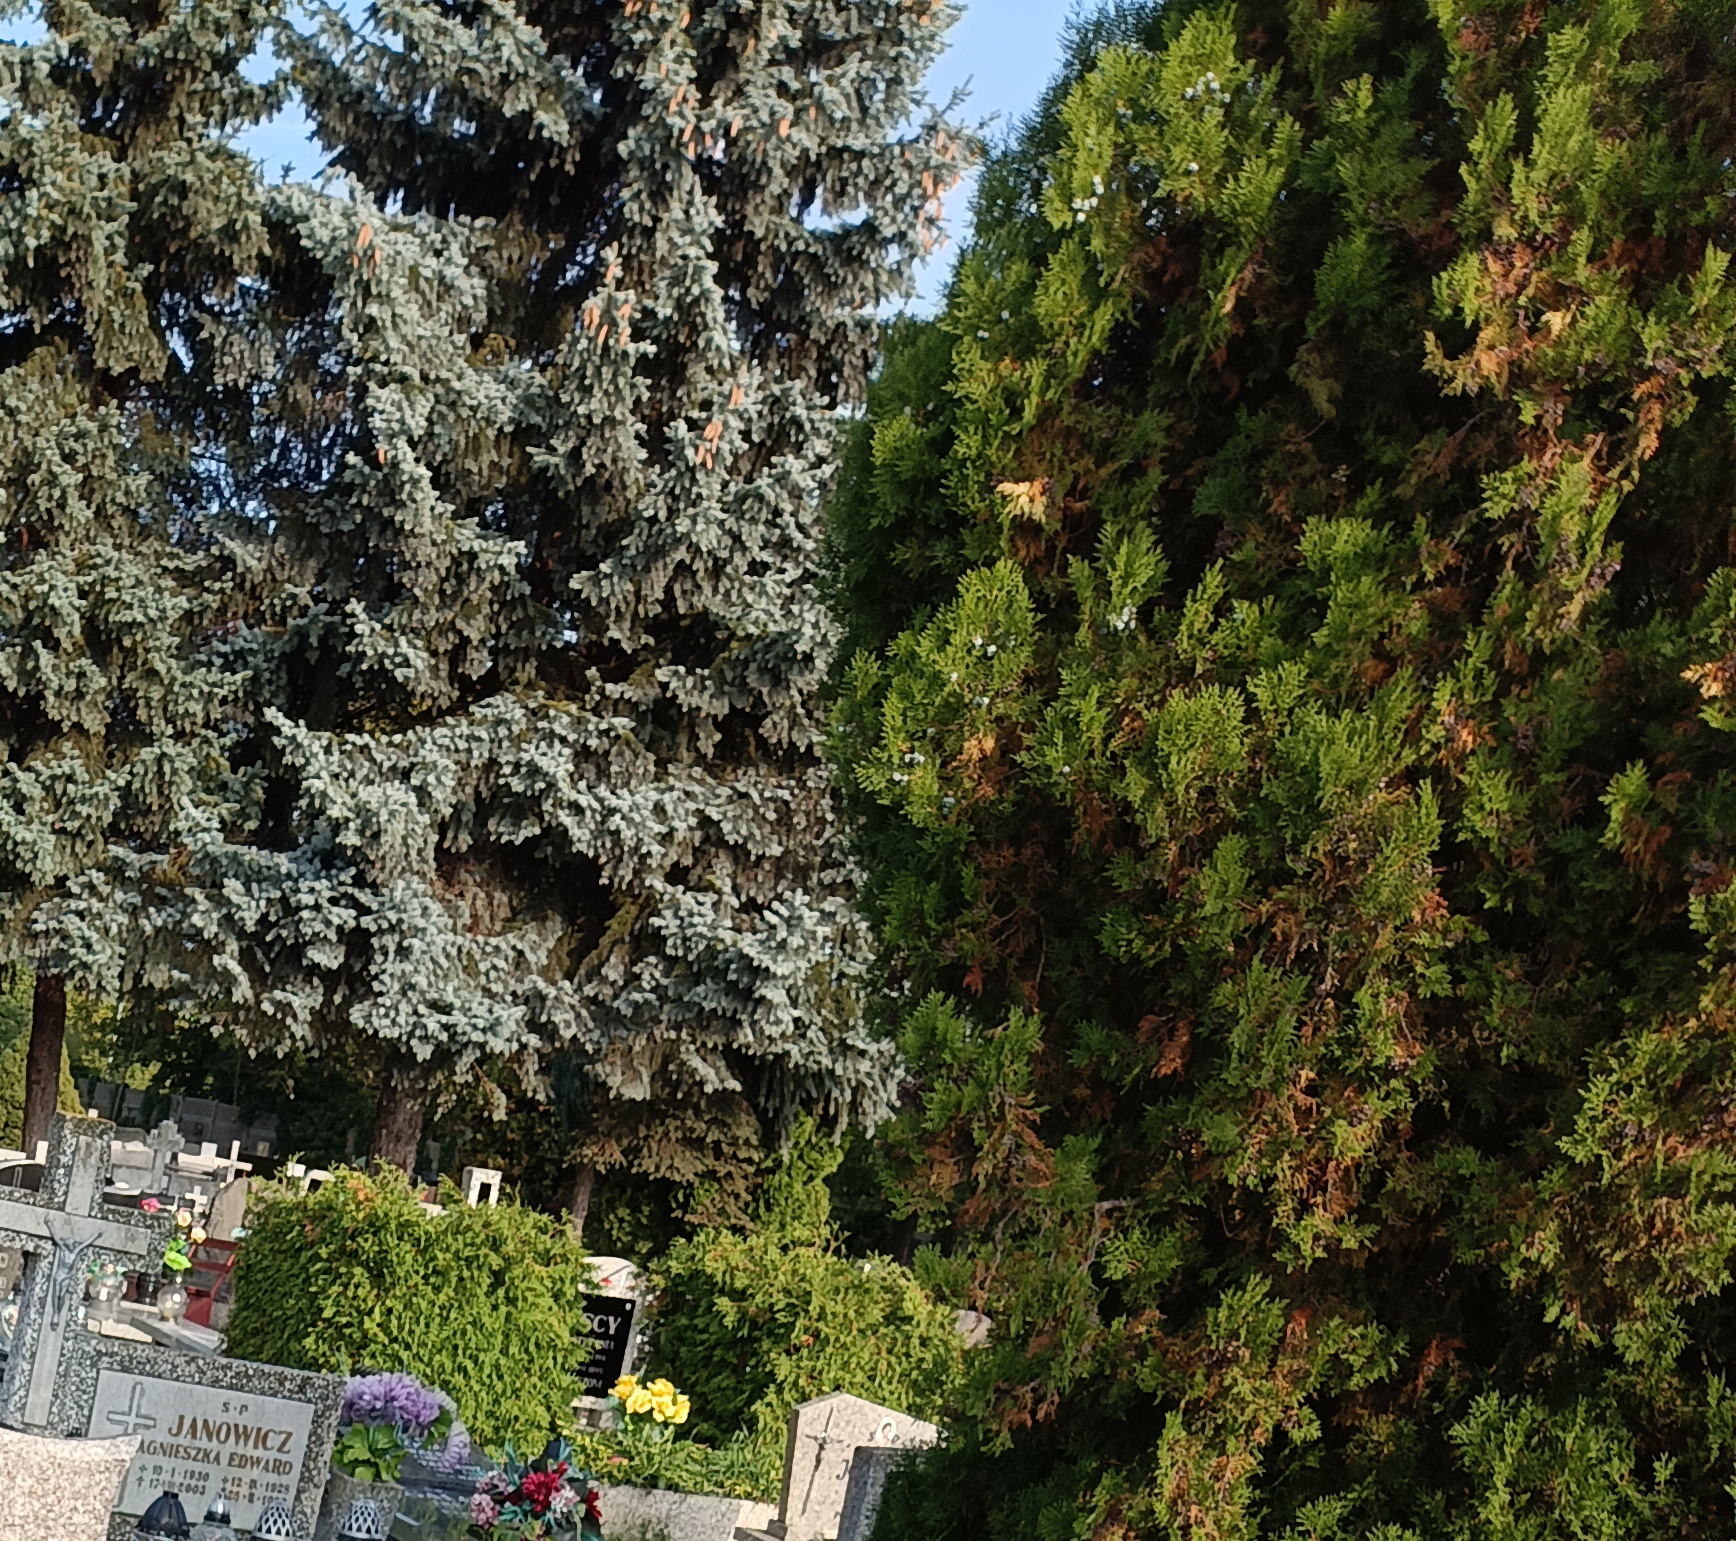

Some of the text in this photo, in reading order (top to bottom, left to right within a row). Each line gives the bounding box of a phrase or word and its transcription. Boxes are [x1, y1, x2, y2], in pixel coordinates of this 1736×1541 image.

[167, 1414, 295, 1454] JANOWICZ
[136, 1439, 294, 1476] AGNIESZKA EDWARD
